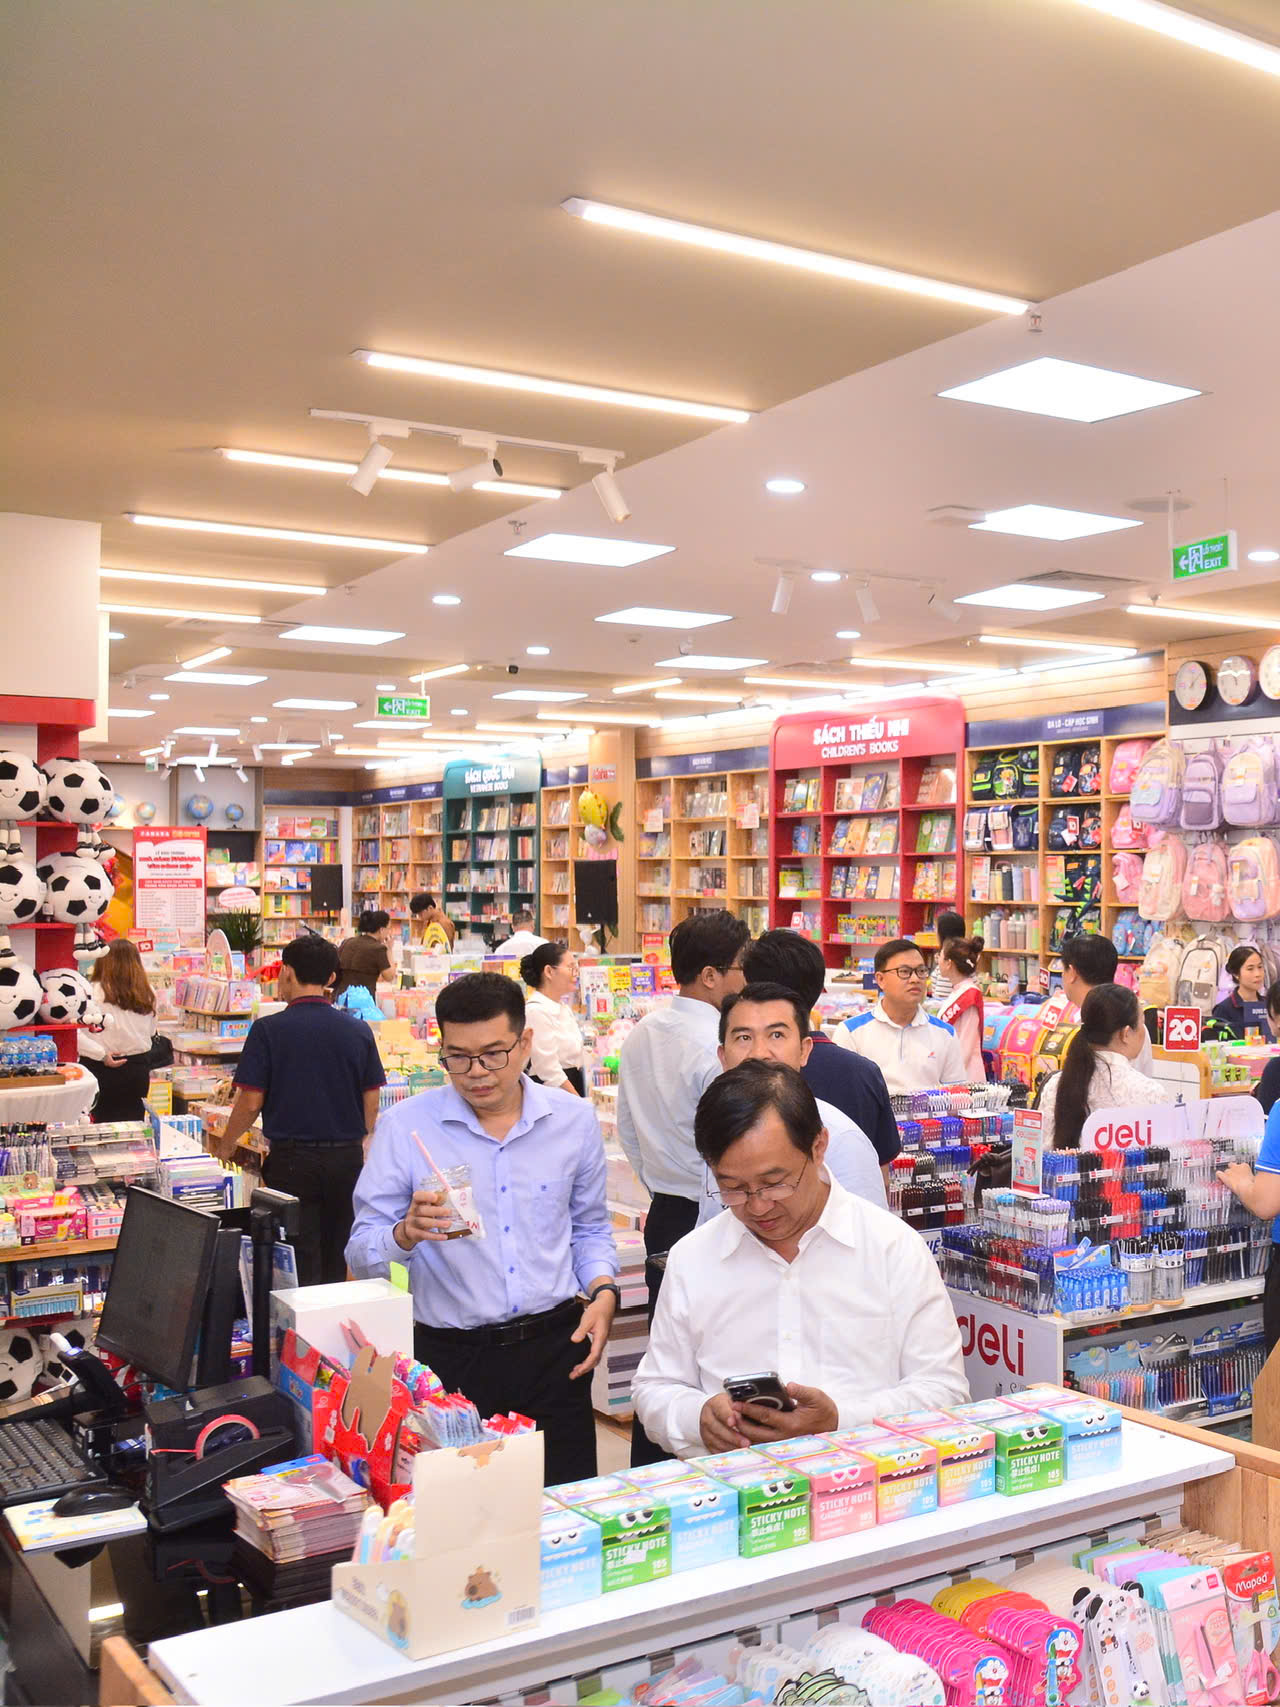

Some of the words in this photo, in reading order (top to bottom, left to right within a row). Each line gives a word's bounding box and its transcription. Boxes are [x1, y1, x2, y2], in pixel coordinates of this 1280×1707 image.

[1204, 556, 1223, 569] EXIT
[813, 724, 846, 745] SÁCH
[849, 715, 885, 741] THIẾU
[887, 718, 910, 738] NHI
[821, 743, 866, 759] CHILDREN'S
[869, 740, 899, 754] BOOKS
[943, 1003, 961, 1022] ASA
[1094, 1120, 1152, 1150] deli
[956, 1314, 1024, 1376] deli
[1011, 1454, 1039, 1470] STICKY
[1039, 1450, 1060, 1464] NOTE
[980, 1478, 992, 1488] 105
[1048, 1469, 1060, 1480] 105
[887, 1479, 913, 1494] STICKY
[913, 1475, 934, 1489] NOTE
[820, 1495, 851, 1512] STICKY
[851, 1490, 872, 1505] NOTE
[922, 1495, 934, 1505] 105
[751, 1509, 785, 1529] STICKY
[784, 1504, 807, 1520] NOTE
[606, 1541, 641, 1560] STICKY
[641, 1535, 667, 1552] NOTE
[541, 1563, 570, 1580] TICKY
[1235, 1572, 1269, 1594] Maped
